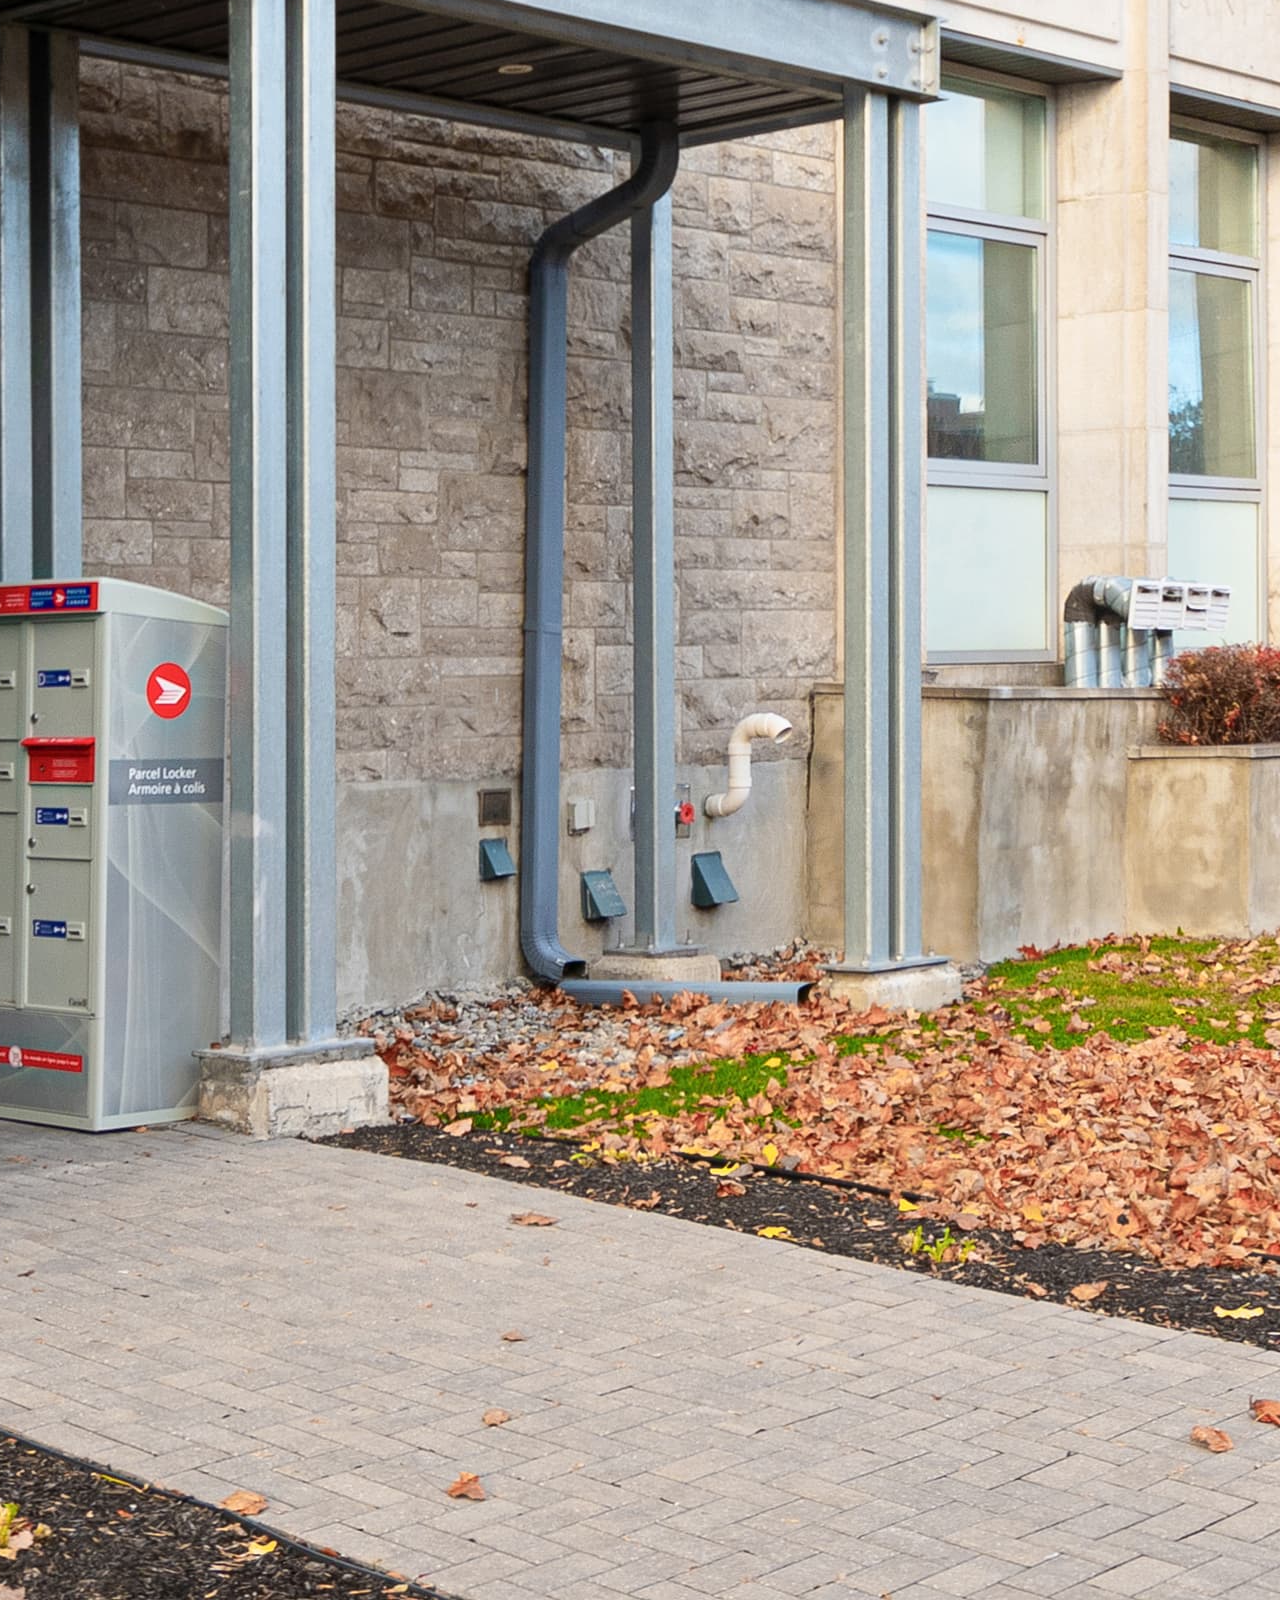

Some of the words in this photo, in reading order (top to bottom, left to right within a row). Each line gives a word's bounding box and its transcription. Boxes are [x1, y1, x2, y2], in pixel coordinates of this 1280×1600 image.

[38, 672, 46, 686] D
[128, 767, 161, 780] Parcel
[162, 766, 197, 779] Locker
[128, 782, 172, 795] Armoire
[173, 783, 181, 794] à
[182, 781, 206, 794] colis
[36, 809, 43, 823] E
[34, 921, 41, 935] F
